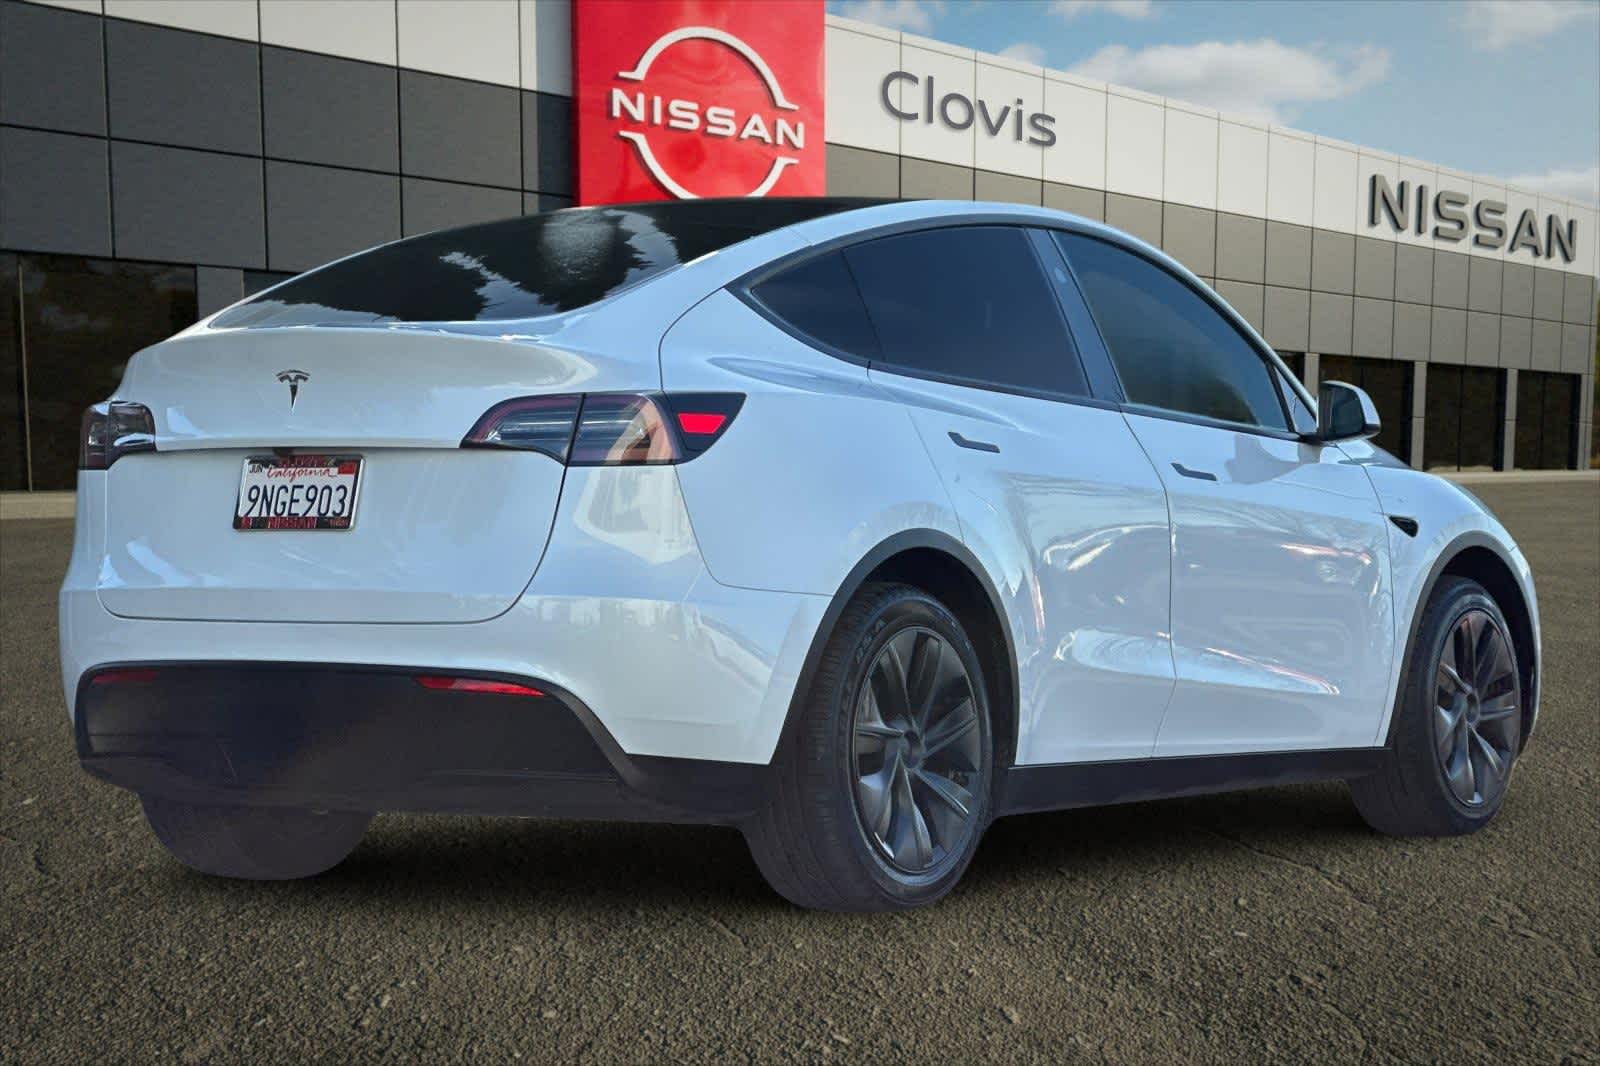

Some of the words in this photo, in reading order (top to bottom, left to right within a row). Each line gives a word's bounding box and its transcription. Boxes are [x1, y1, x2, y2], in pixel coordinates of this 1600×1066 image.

[611, 88, 805, 149] NISSAN
[881, 70, 1057, 147] Clovis
[1368, 174, 1577, 263] NISSAN
[245, 485, 348, 517] 9NGE903
[267, 464, 337, 483] California
